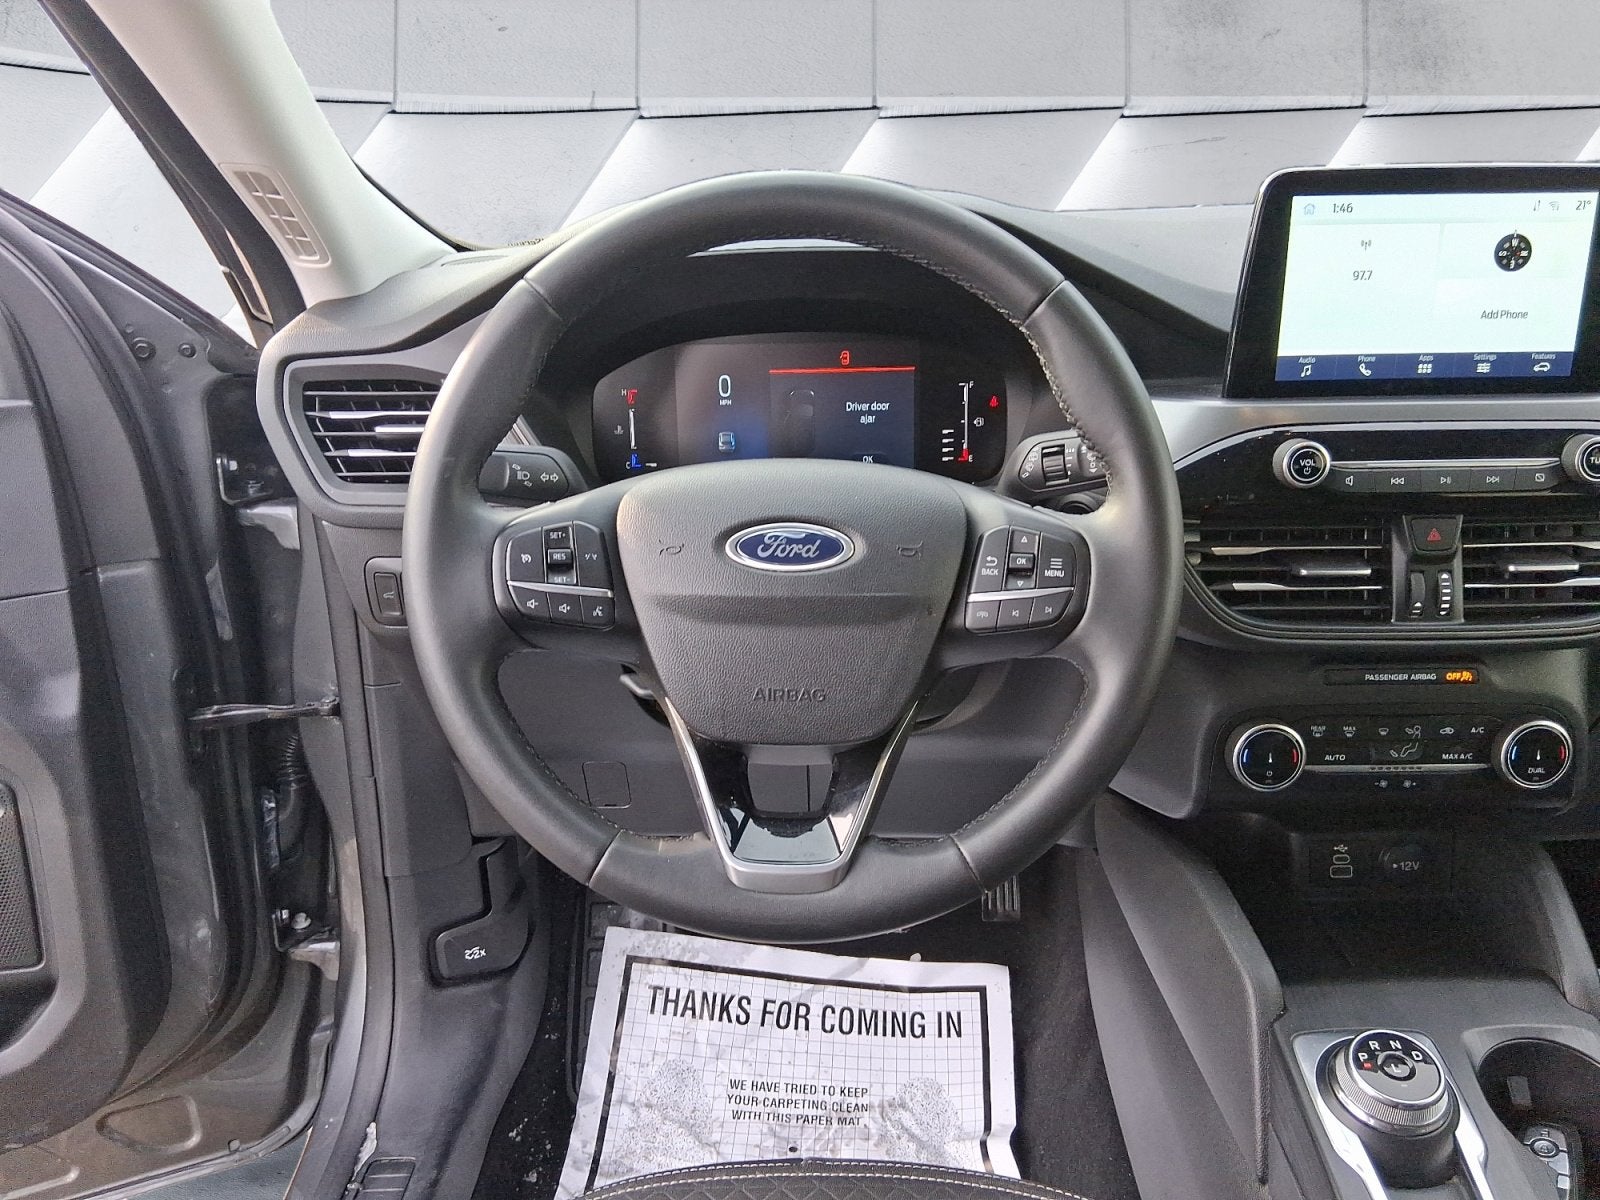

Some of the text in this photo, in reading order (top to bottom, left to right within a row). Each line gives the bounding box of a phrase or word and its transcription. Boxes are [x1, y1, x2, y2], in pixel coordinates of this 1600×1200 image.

[1332, 202, 1353, 213] 1:46
[1352, 270, 1373, 281] 97.7
[1480, 308, 1529, 320] Add Phone
[1357, 355, 1377, 363] Phone
[1418, 354, 1434, 363] Apps
[1473, 353, 1497, 362] Settings
[718, 374, 731, 398] 0
[846, 401, 890, 412] Driver door
[860, 413, 876, 425] ajar
[862, 455, 874, 464] OK
[1299, 459, 1316, 467] VOL
[1589, 456, 1600, 464] TU
[757, 531, 821, 559] Ford
[552, 552, 566, 561] RES
[1016, 557, 1027, 565] OK
[981, 567, 999, 576] BACK
[1044, 569, 1065, 577] MENU
[1364, 671, 1461, 682] PASSENGER AIRBAG OFF
[752, 687, 826, 702] AIRBAG
[1470, 726, 1485, 734] A/C
[1324, 754, 1346, 762] AUTO
[1441, 752, 1473, 760] MAX A/C
[1399, 860, 1420, 871] 12V
[647, 984, 963, 1039] THANKS FOR COMING IN
[1368, 1040, 1380, 1050] R
[1389, 1040, 1402, 1050] N
[1357, 1052, 1368, 1062] P
[1411, 1051, 1423, 1061] D
[729, 1078, 869, 1098] WE HAVE TRIED TO KEEP
[727, 1093, 869, 1114] YOUR CARPETING CLEAN
[731, 1109, 762, 1121] WITH
[765, 1111, 792, 1123] THIS
[795, 1114, 833, 1126] PAPER
